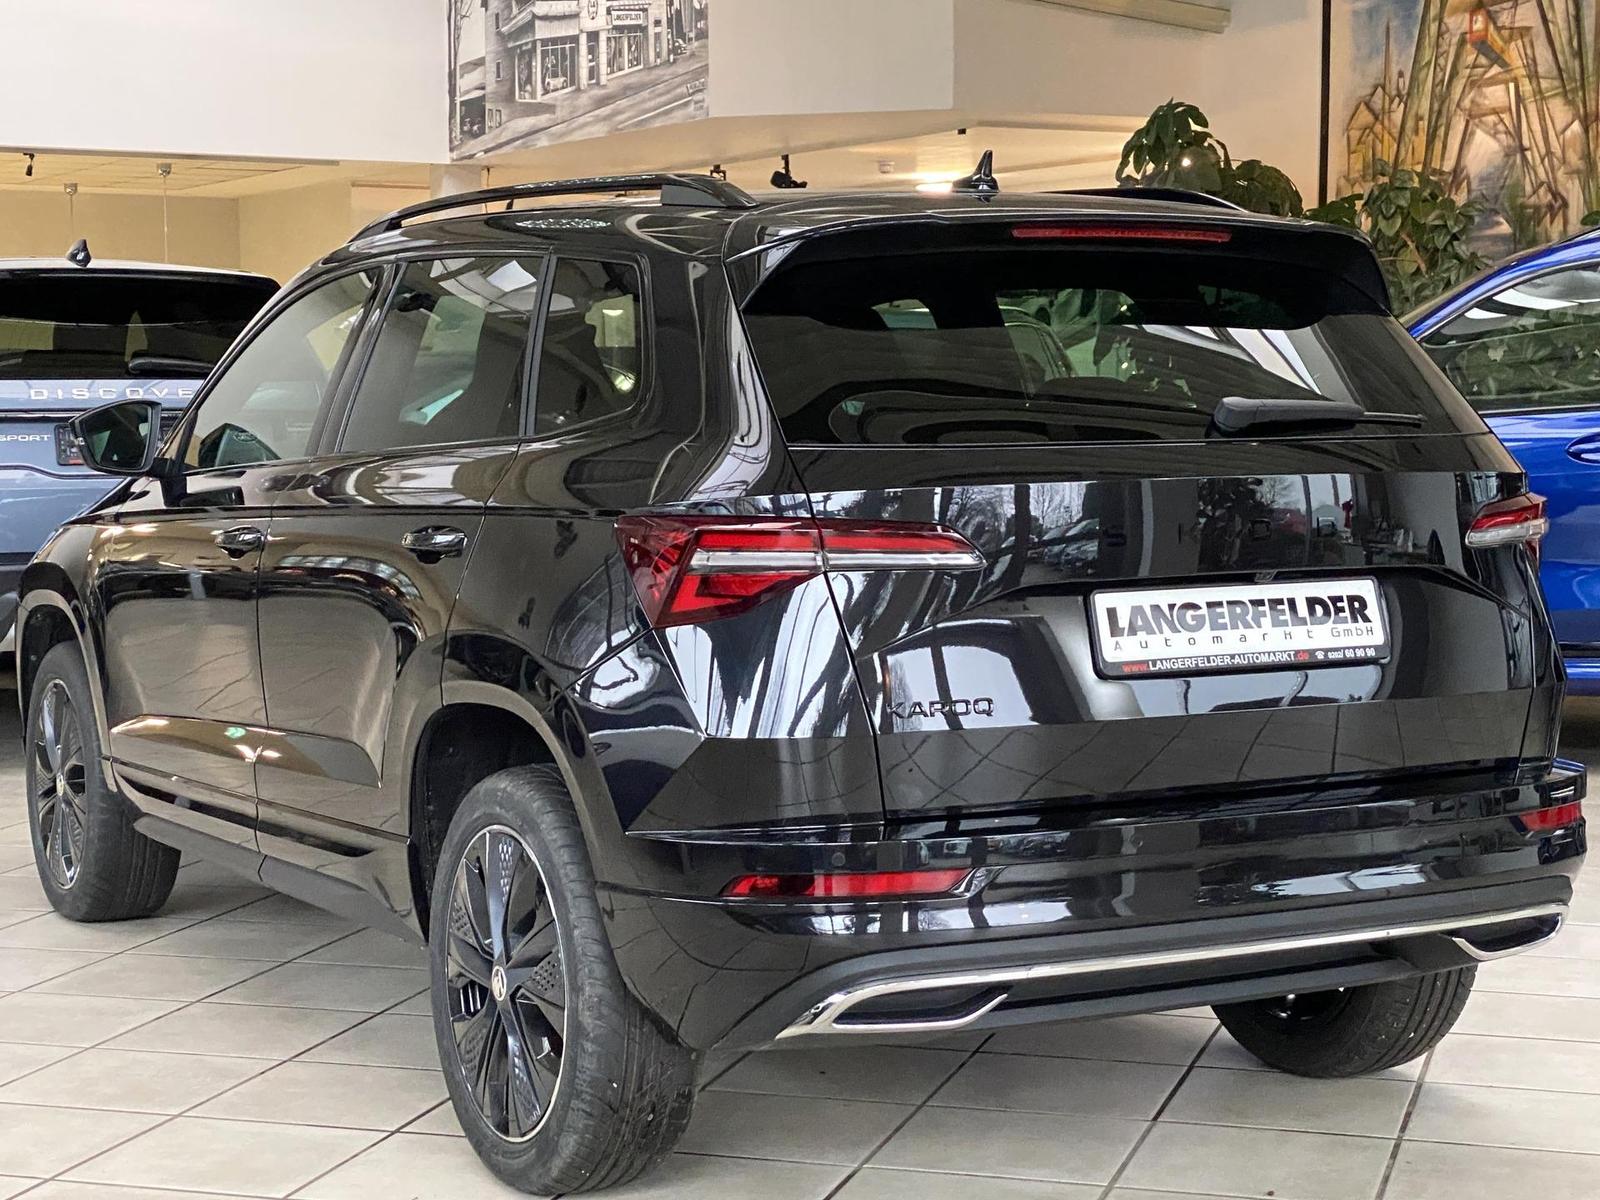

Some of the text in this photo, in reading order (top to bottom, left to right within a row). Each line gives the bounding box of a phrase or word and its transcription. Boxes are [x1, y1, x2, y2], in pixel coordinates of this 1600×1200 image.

[1105, 594, 1373, 638] LANGERFELDER
[1113, 625, 1374, 652] Automarkt GmbH
[886, 697, 994, 718] KAROQ
